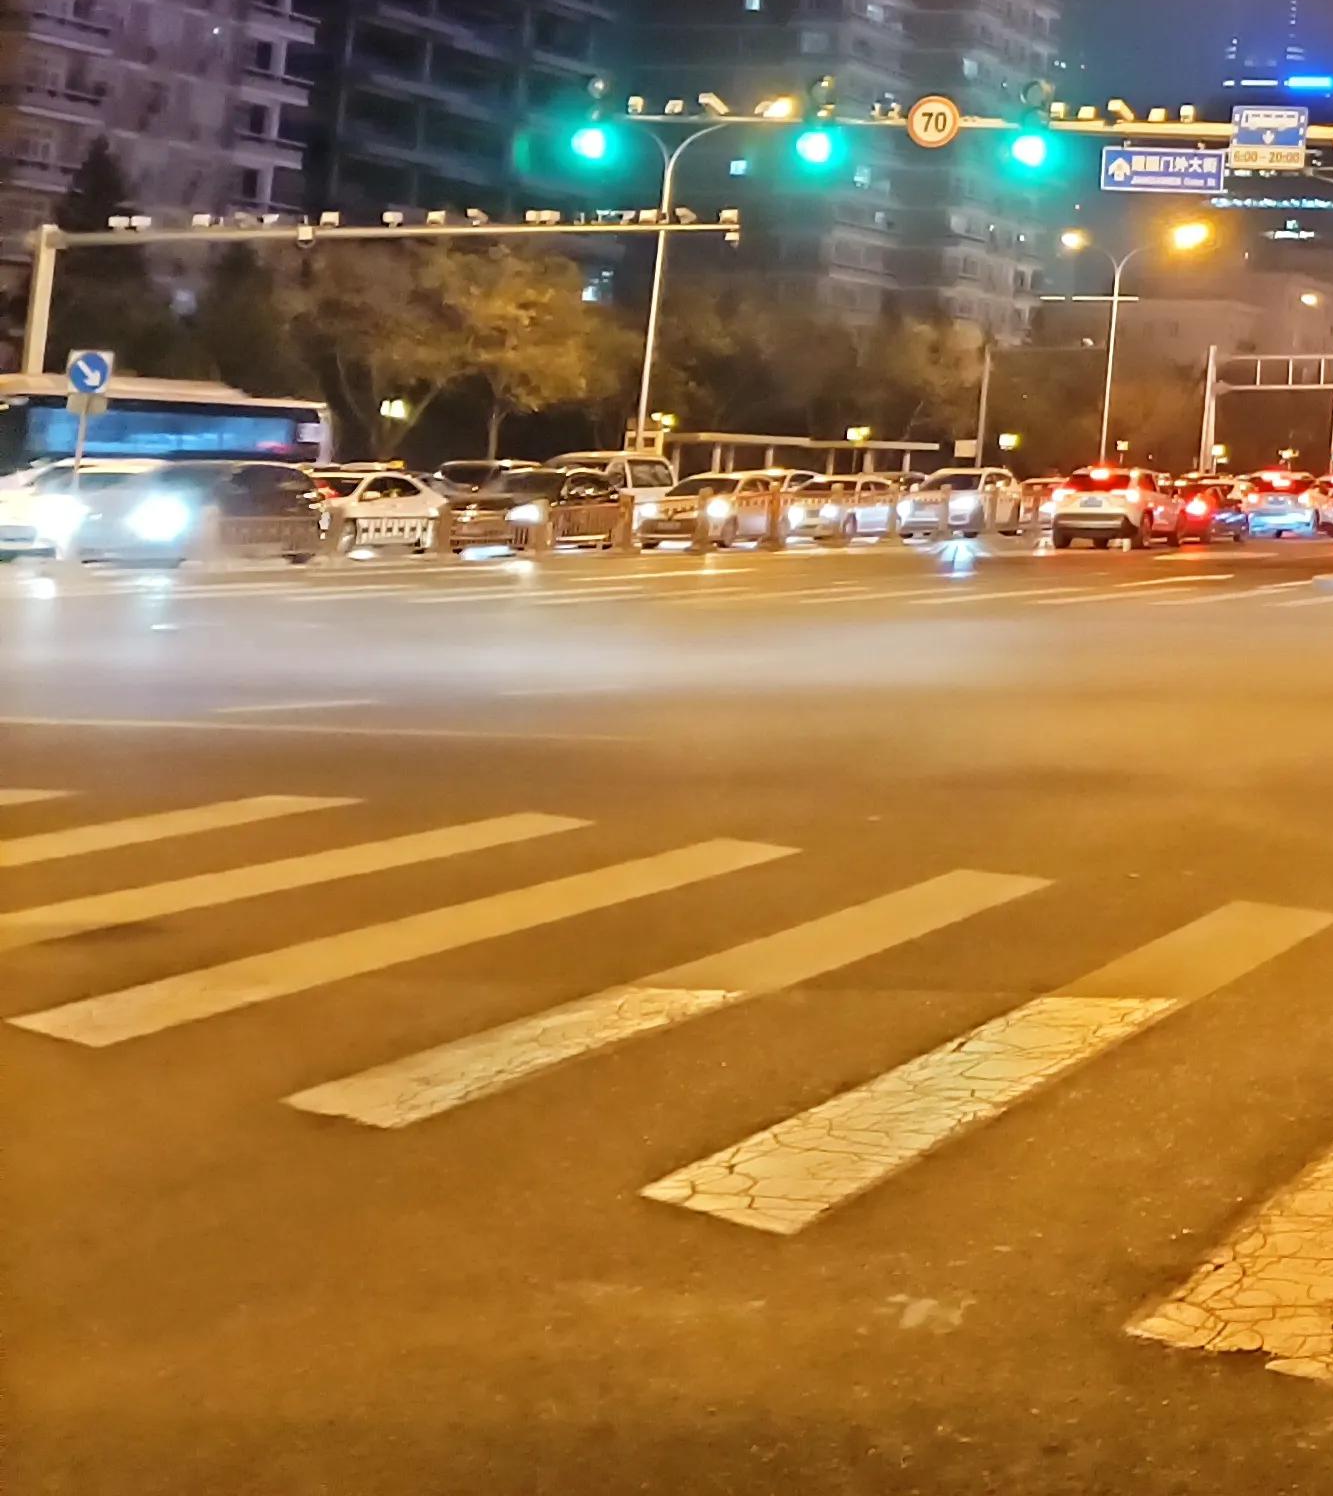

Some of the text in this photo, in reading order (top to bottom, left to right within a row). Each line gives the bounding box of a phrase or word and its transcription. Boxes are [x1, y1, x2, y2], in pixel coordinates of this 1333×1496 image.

[922, 112, 947, 133] 70
[1131, 155, 1218, 174] 门外大街
